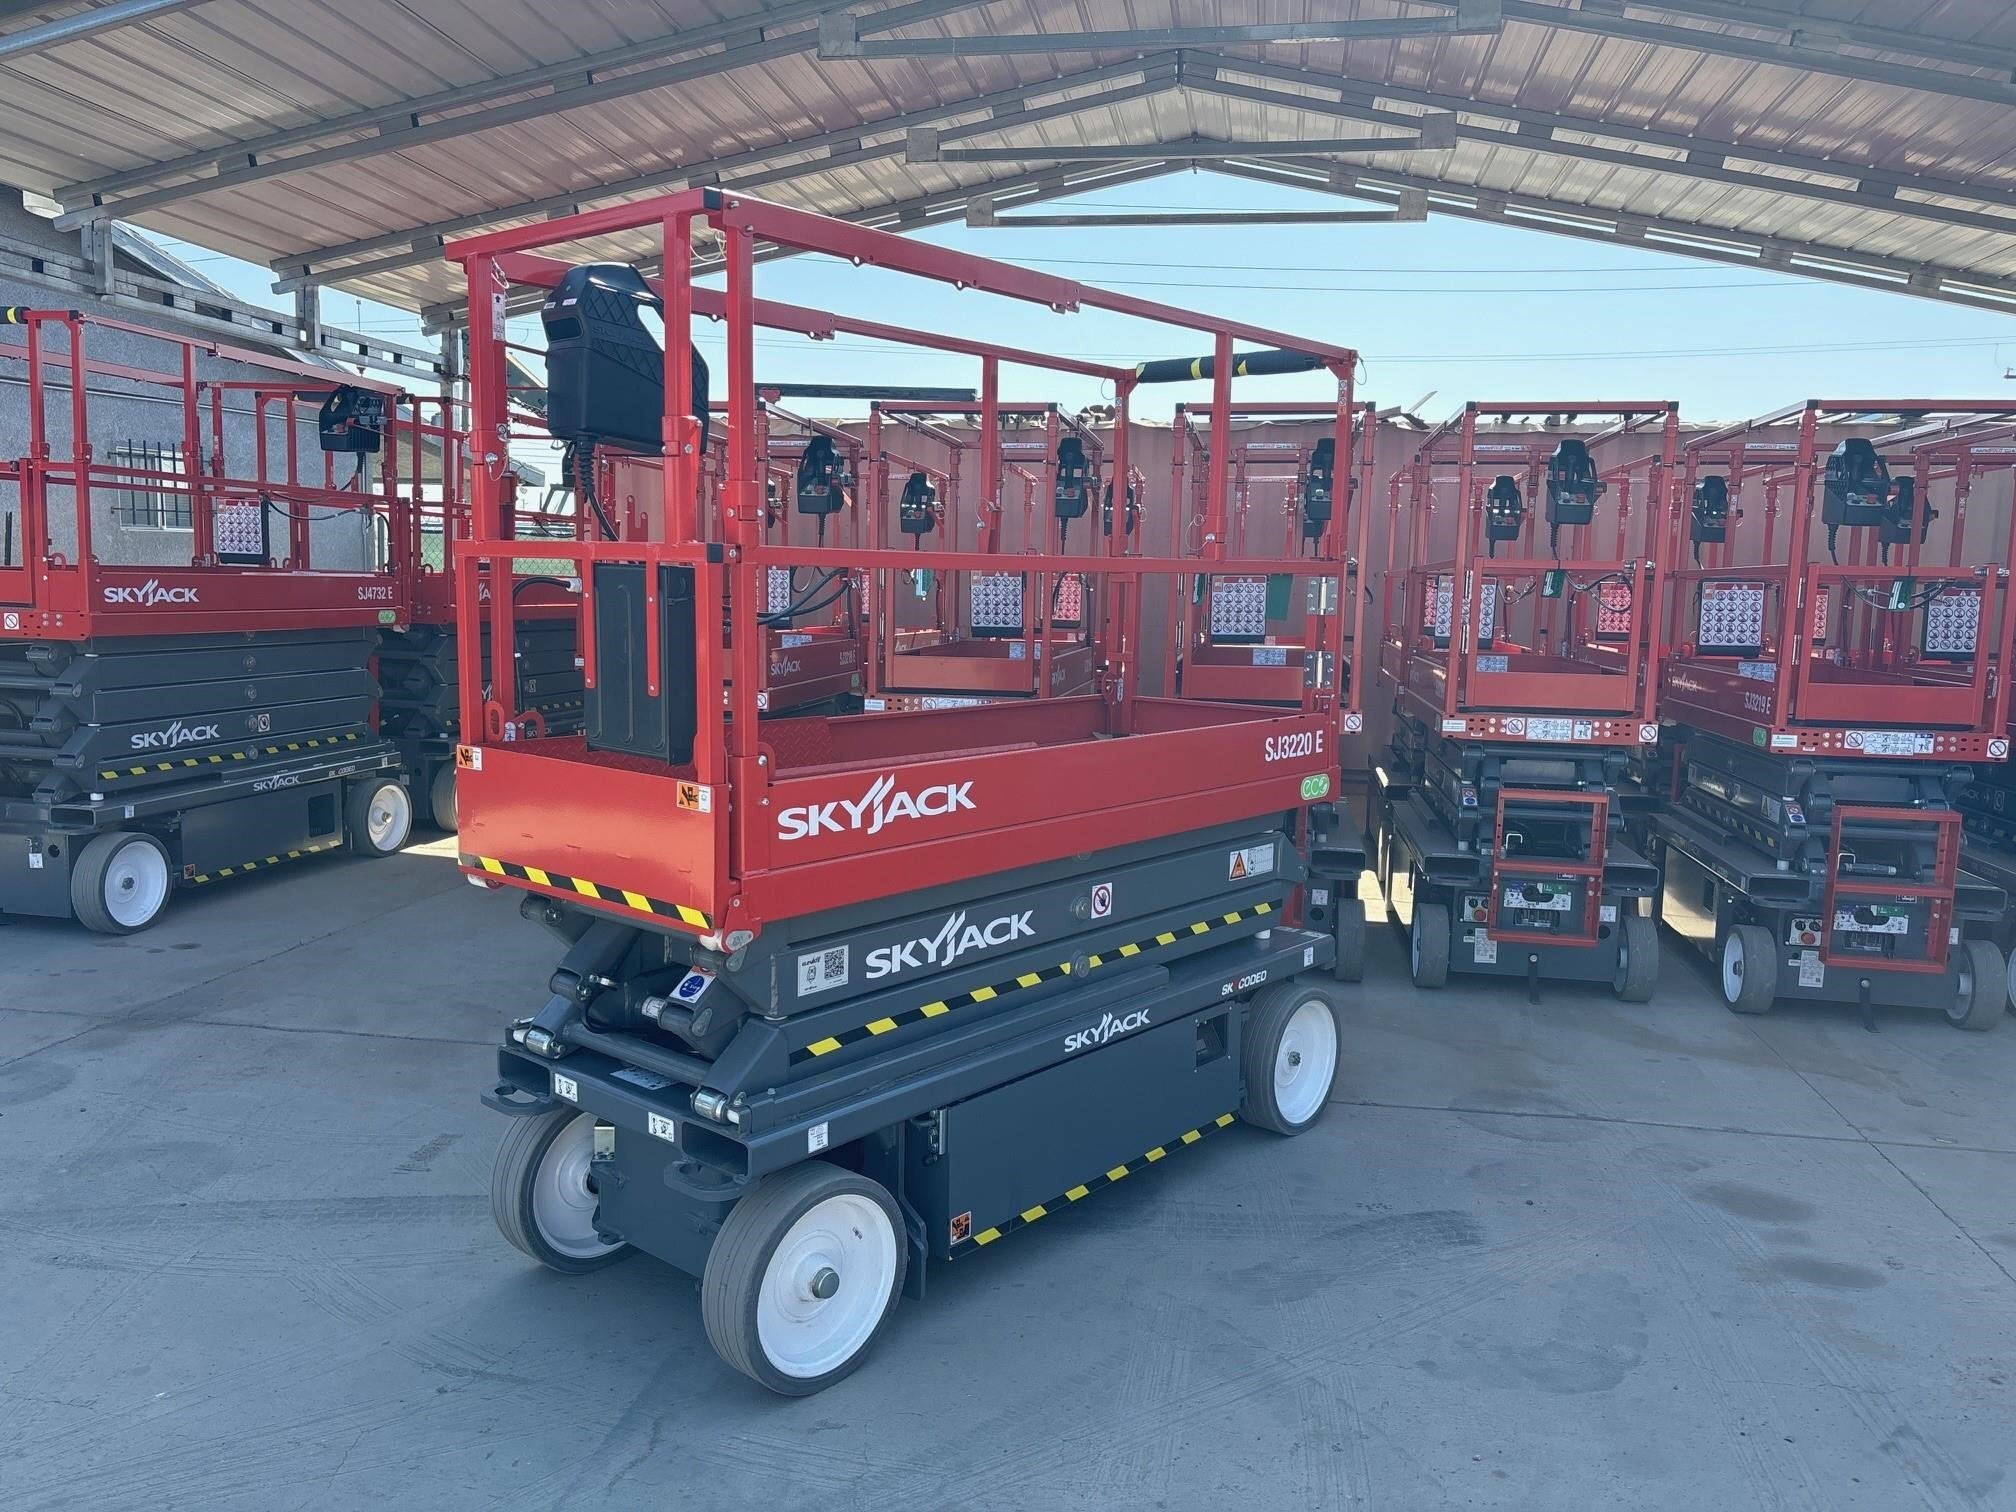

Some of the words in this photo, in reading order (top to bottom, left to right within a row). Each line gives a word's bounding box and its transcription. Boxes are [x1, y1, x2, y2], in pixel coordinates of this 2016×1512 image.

[103, 578, 200, 607] SKYJACK
[357, 586, 386, 601] SJ4732
[387, 585, 393, 600] E
[770, 655, 801, 677] SKYJACK
[1744, 691, 1765, 713] SJ3219
[1766, 697, 1772, 715] E
[131, 720, 221, 750] SKYJACK
[526, 727, 553, 739] SKYCK
[1264, 733, 1312, 762] SJ3220
[1315, 729, 1323, 753] E
[253, 774, 300, 792] SKYJACK
[777, 772, 977, 840] SKYJACK
[865, 910, 1036, 979] SKYJACK
[1064, 1008, 1151, 1053] SKYJACK
